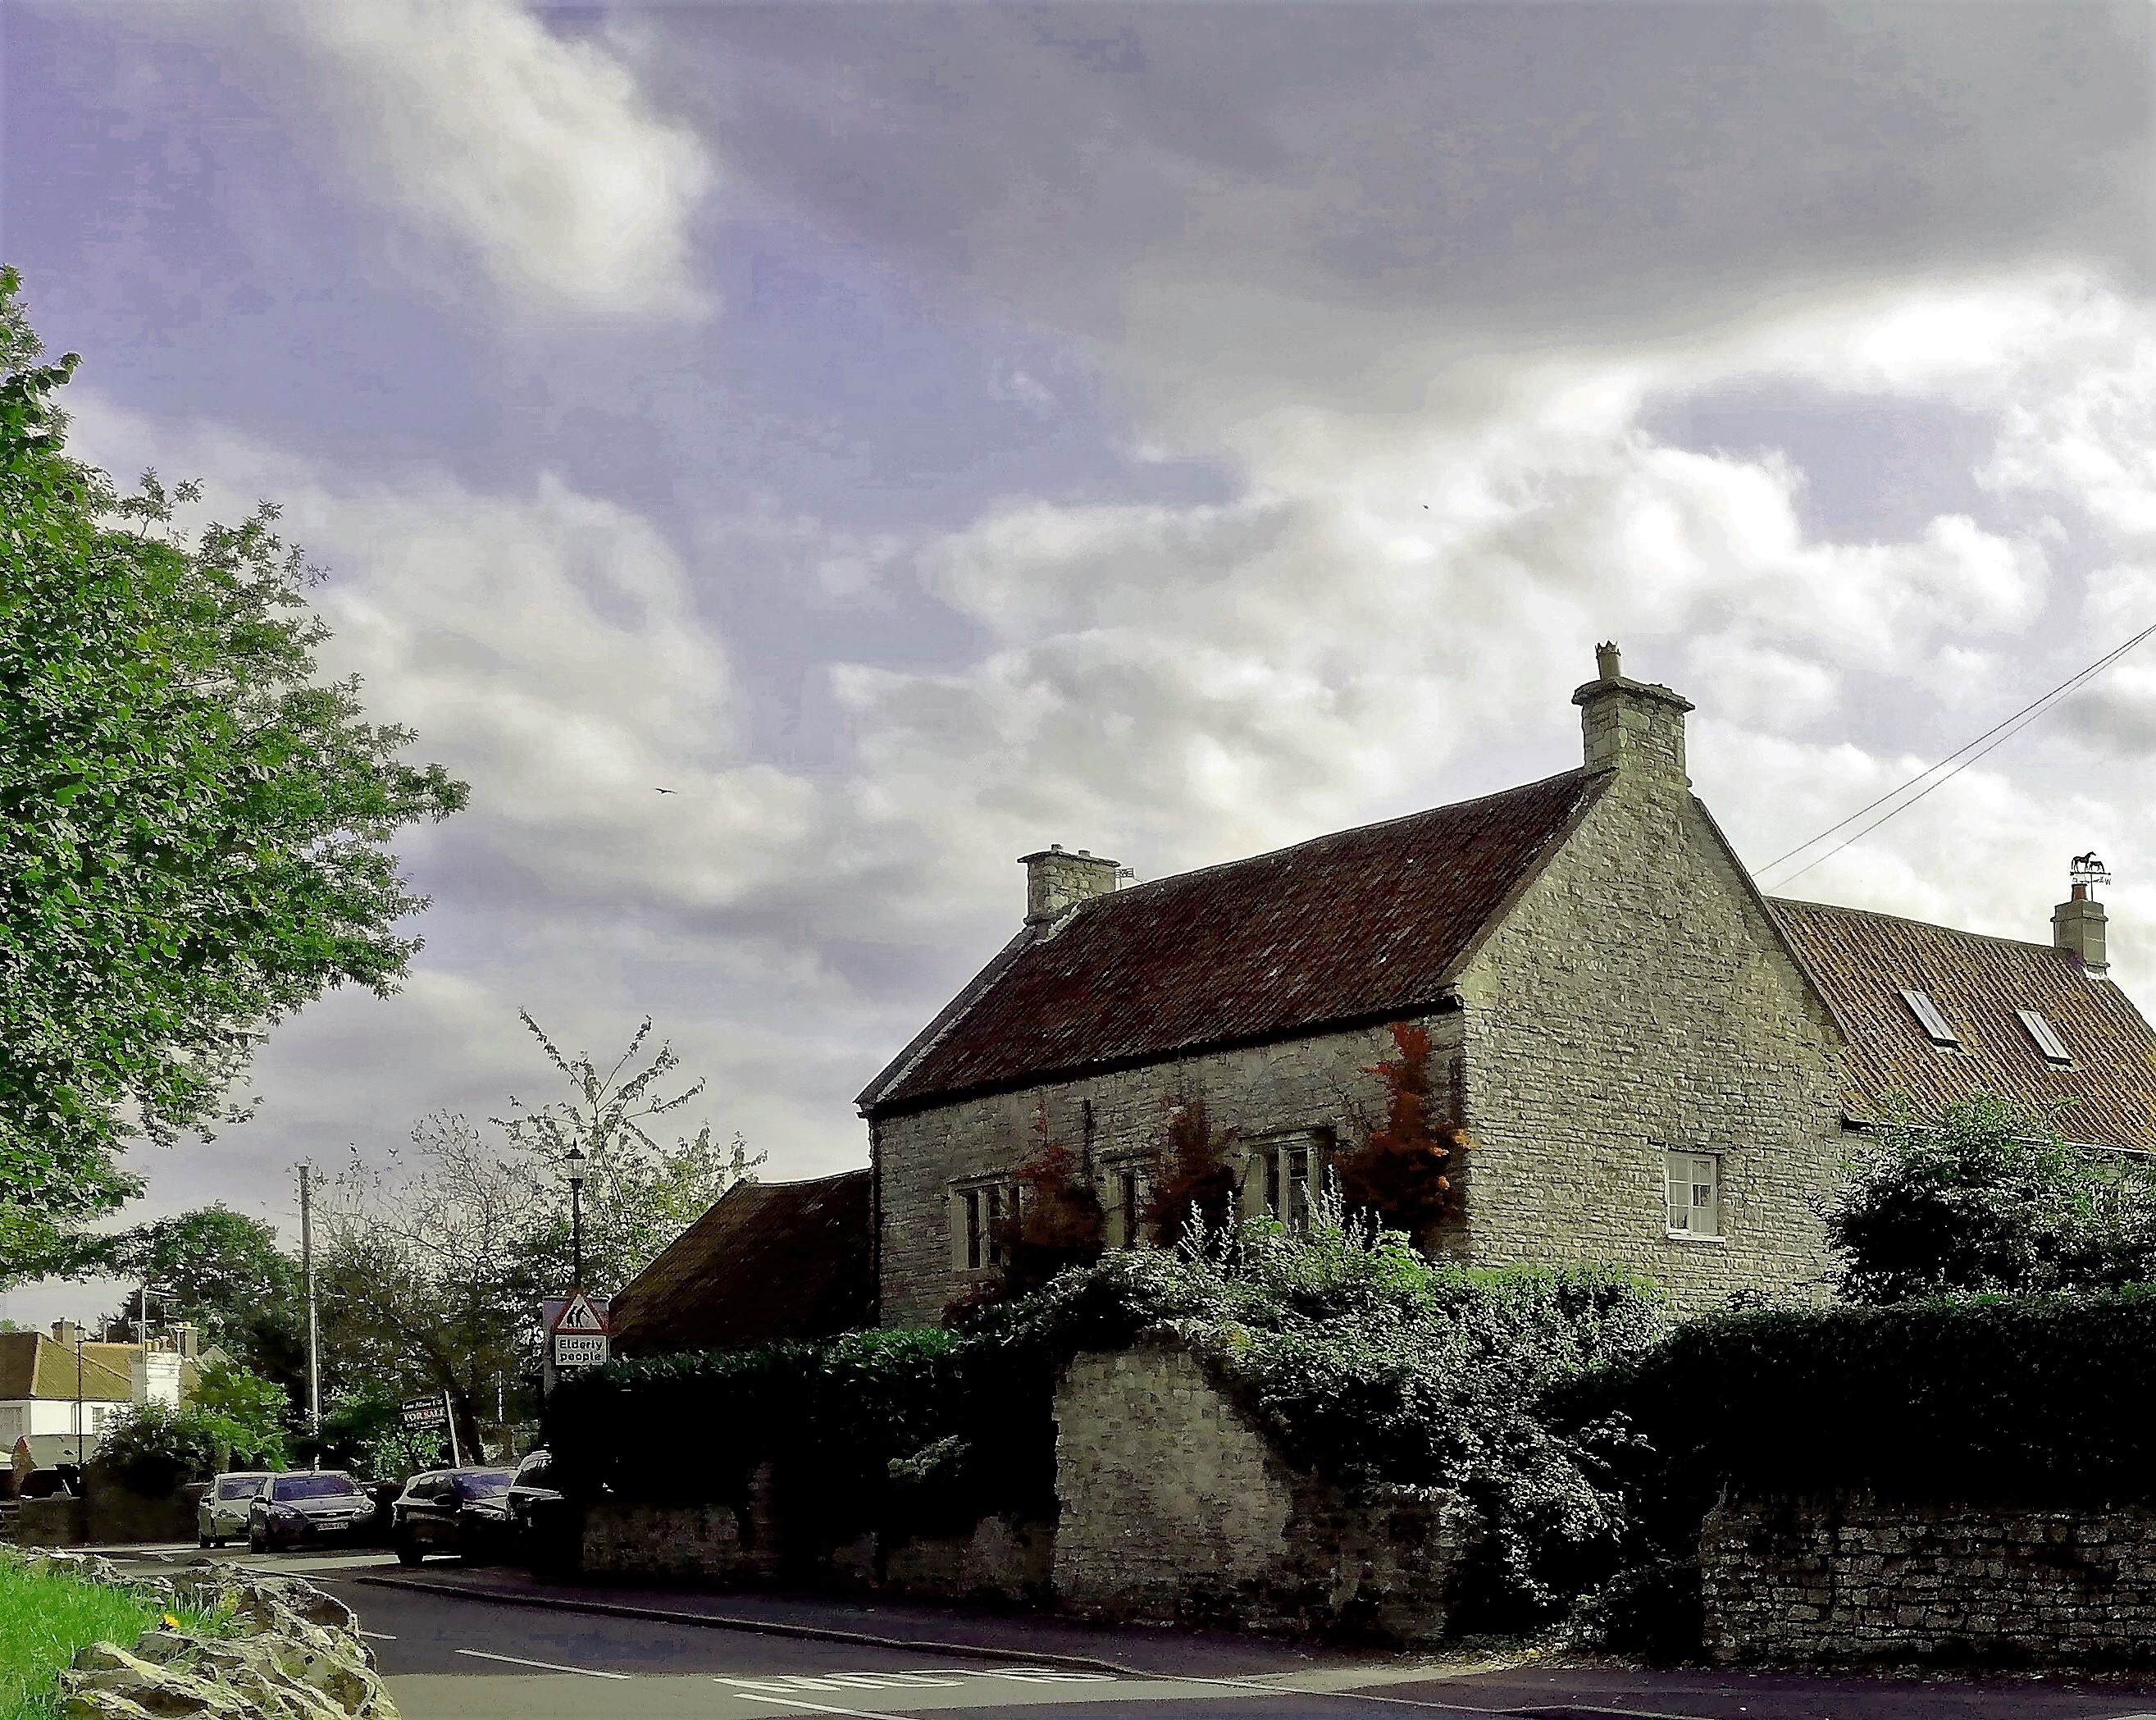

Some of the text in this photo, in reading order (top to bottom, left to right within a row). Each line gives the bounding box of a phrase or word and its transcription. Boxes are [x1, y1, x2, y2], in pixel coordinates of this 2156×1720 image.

[559, 1339, 602, 1351] Elderly
[560, 1352, 601, 1362] people
[713, 1668, 1117, 1693] SLOW
